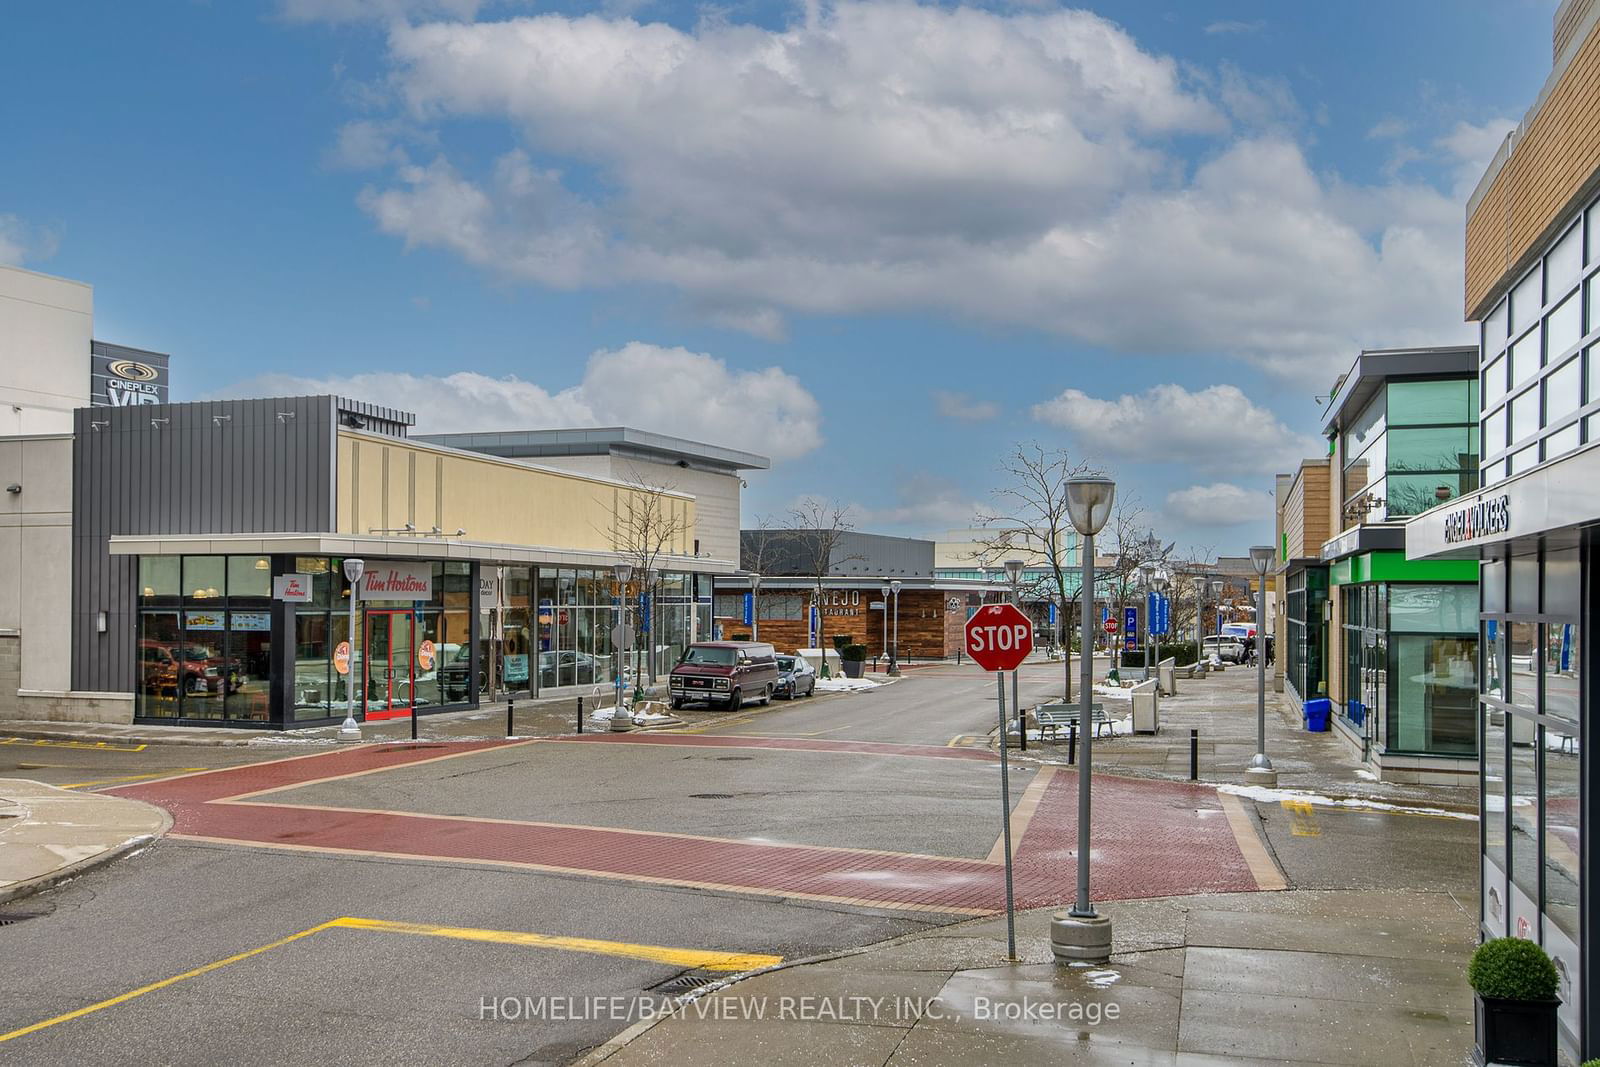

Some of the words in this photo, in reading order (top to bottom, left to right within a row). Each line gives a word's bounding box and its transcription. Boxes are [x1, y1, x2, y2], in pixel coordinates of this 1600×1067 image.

[110, 380, 158, 394] CINEPLEX
[289, 580, 299, 588] Tim
[364, 570, 385, 592] Tim
[386, 568, 427, 593] Hortons
[1127, 617, 1135, 626] P
[970, 624, 1028, 652] STOP
